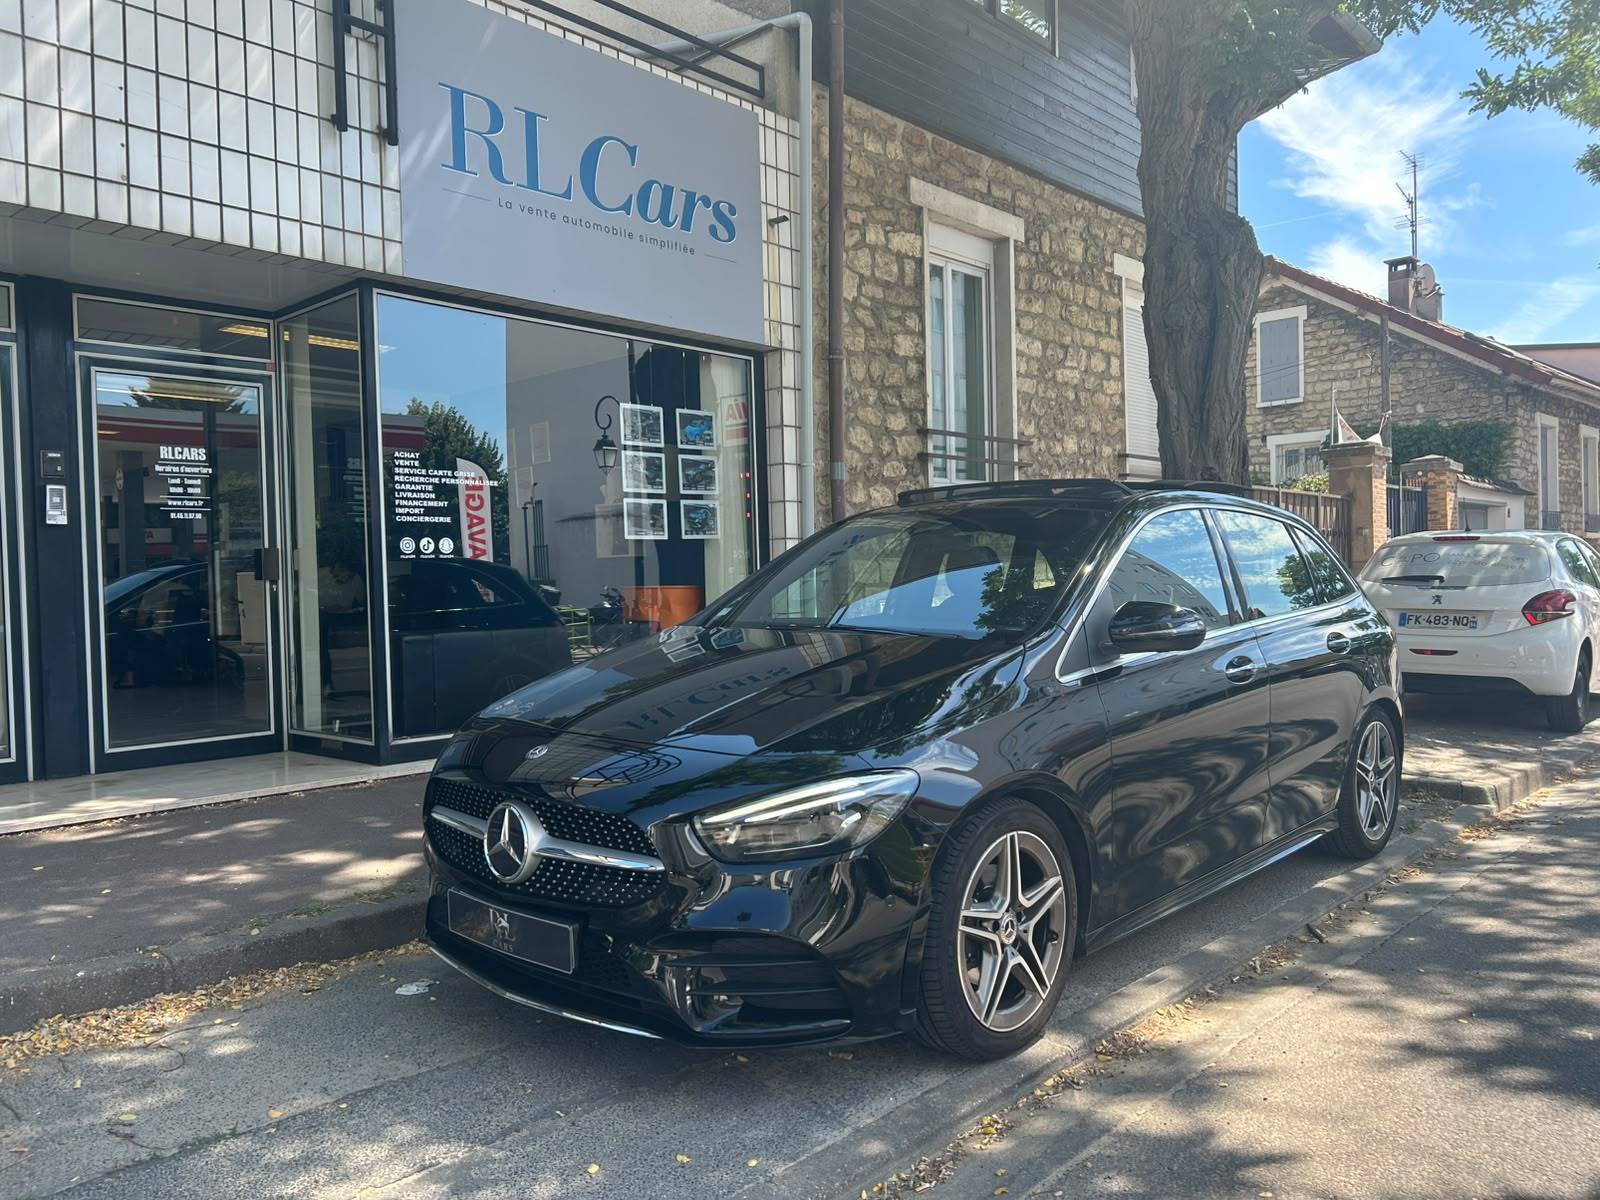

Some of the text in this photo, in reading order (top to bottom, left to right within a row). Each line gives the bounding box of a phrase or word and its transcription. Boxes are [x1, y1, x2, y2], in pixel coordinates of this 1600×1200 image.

[438, 82, 737, 244] RLCars
[498, 197, 696, 255] La vente automobile simplifiée
[159, 445, 207, 461] RLCARS
[394, 451, 420, 459] ACHAT
[394, 459, 420, 467] VENTE
[394, 467, 477, 478] SERVICE CARTE GRISE
[394, 475, 440, 484] RECHERCHE
[394, 483, 434, 492] GARANTIE
[395, 491, 436, 499] LIVRAISON
[395, 499, 449, 507] FINANCEMENT
[396, 515, 452, 523] CONCIERGERIE
[1406, 614, 1469, 627] FK-483-NQ
